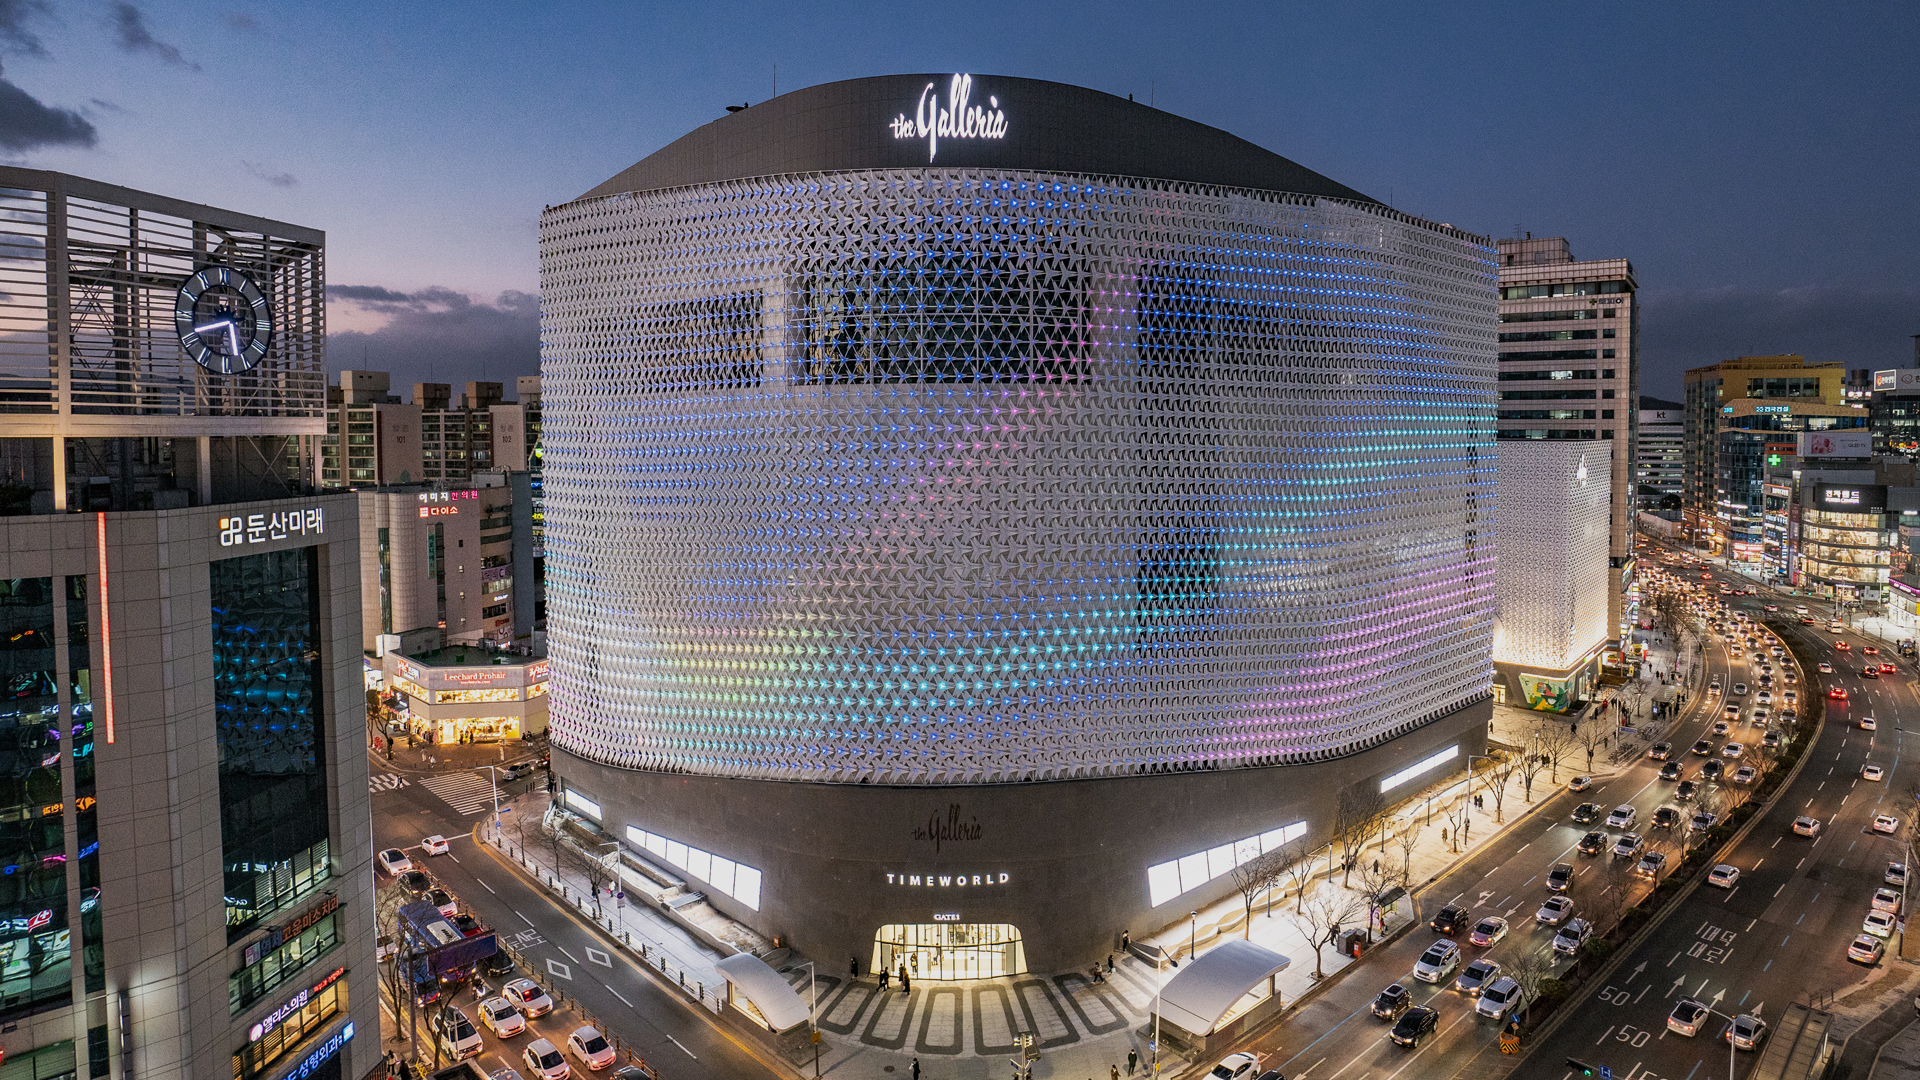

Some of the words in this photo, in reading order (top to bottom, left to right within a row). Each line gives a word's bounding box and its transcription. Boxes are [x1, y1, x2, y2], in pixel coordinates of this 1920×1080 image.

[889, 113, 917, 139] the
[916, 72, 1009, 164] Galleria
[430, 505, 459, 516] 다이소
[246, 507, 324, 544] 둔산미래
[479, 671, 507, 680] Prohair
[911, 826, 928, 841] the
[928, 803, 983, 854] Galleria
[887, 873, 1010, 886] TIMEWORLD
[1598, 985, 1631, 1006] 50
[1616, 1024, 1651, 1048] 50
